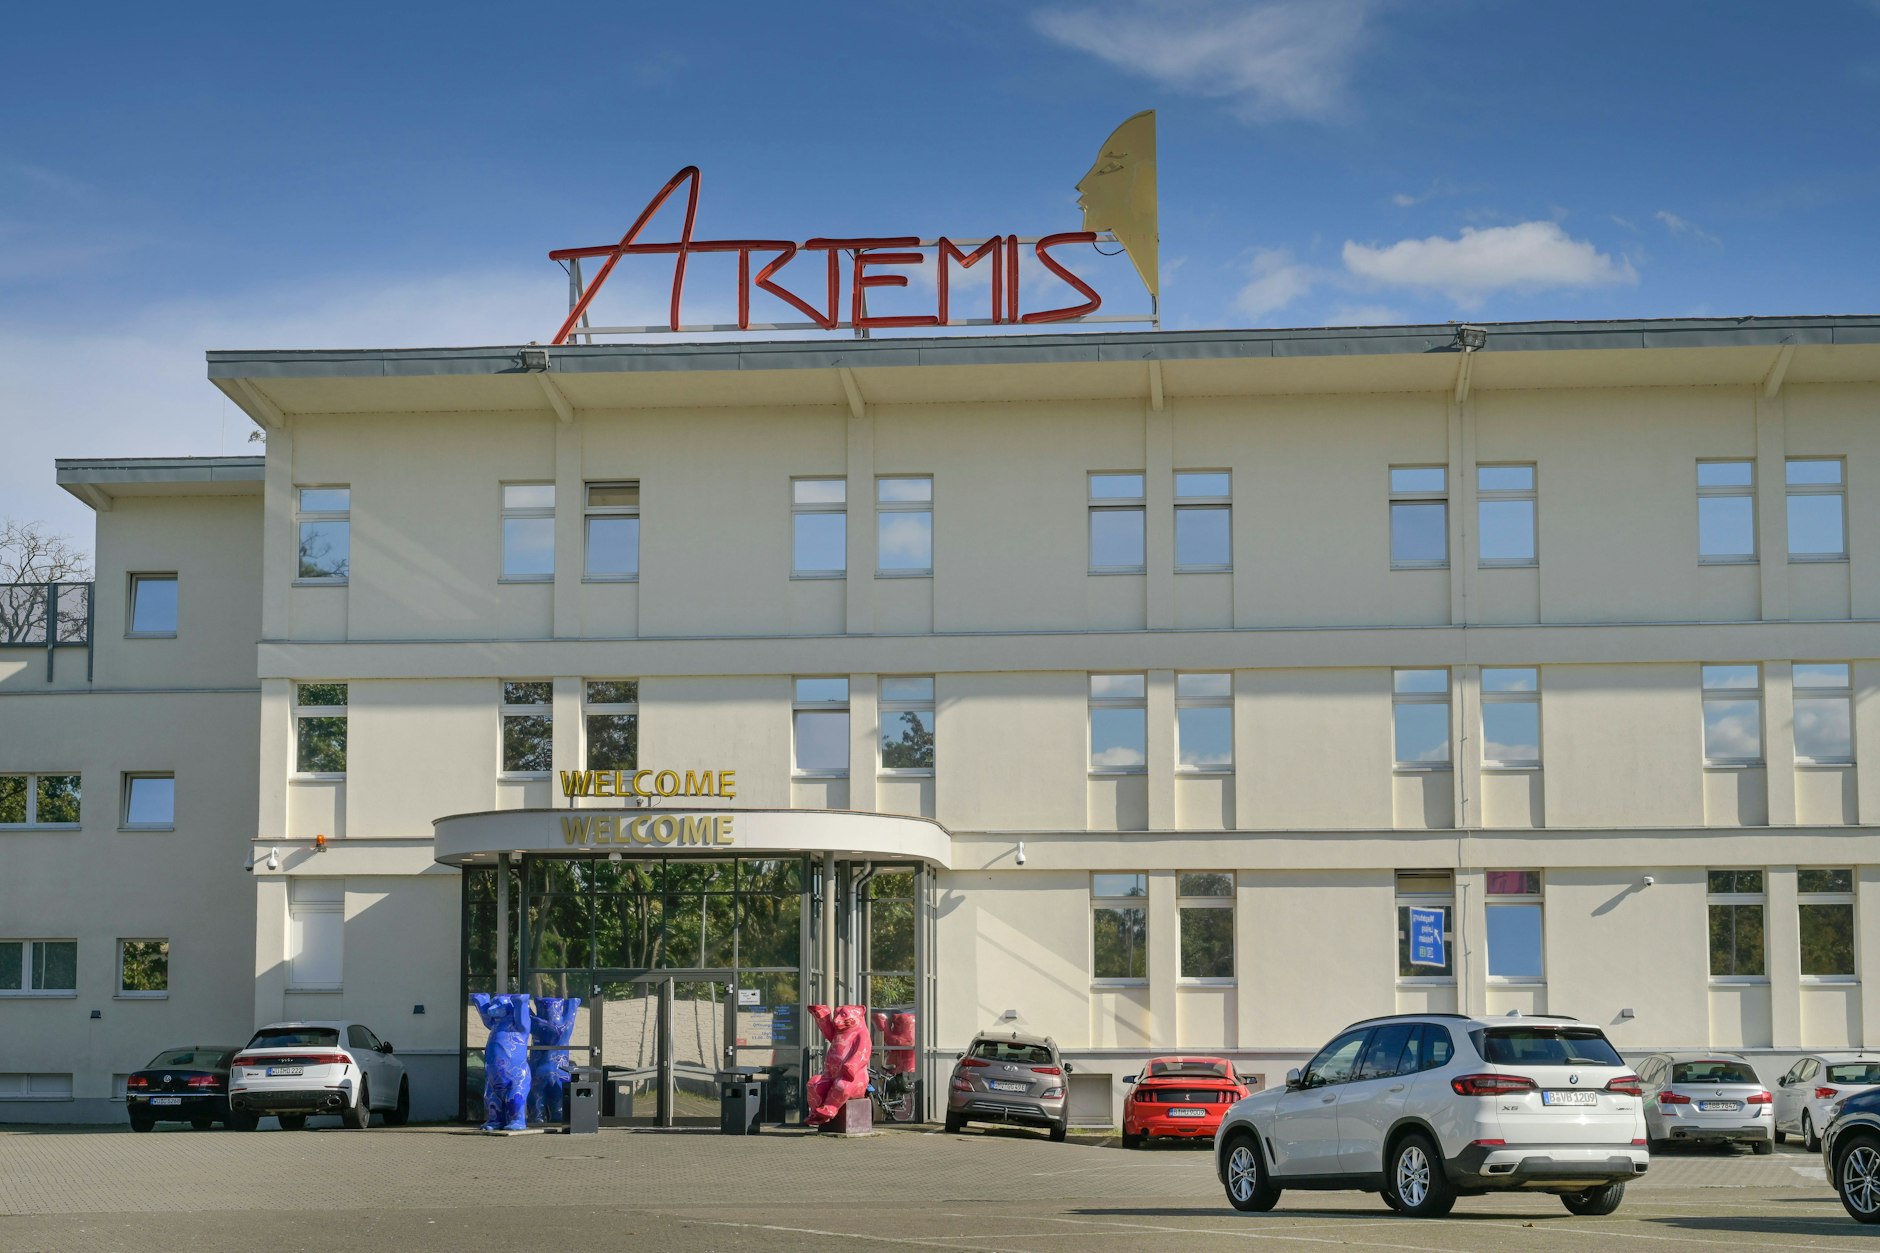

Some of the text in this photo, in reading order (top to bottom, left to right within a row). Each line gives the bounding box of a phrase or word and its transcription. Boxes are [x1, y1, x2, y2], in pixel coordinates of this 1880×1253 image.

[549, 165, 1102, 345] ARTEMIS
[560, 770, 737, 797] WELCOME
[561, 815, 735, 845] WELCOME
[1573, 1092, 1595, 1103] 1209
